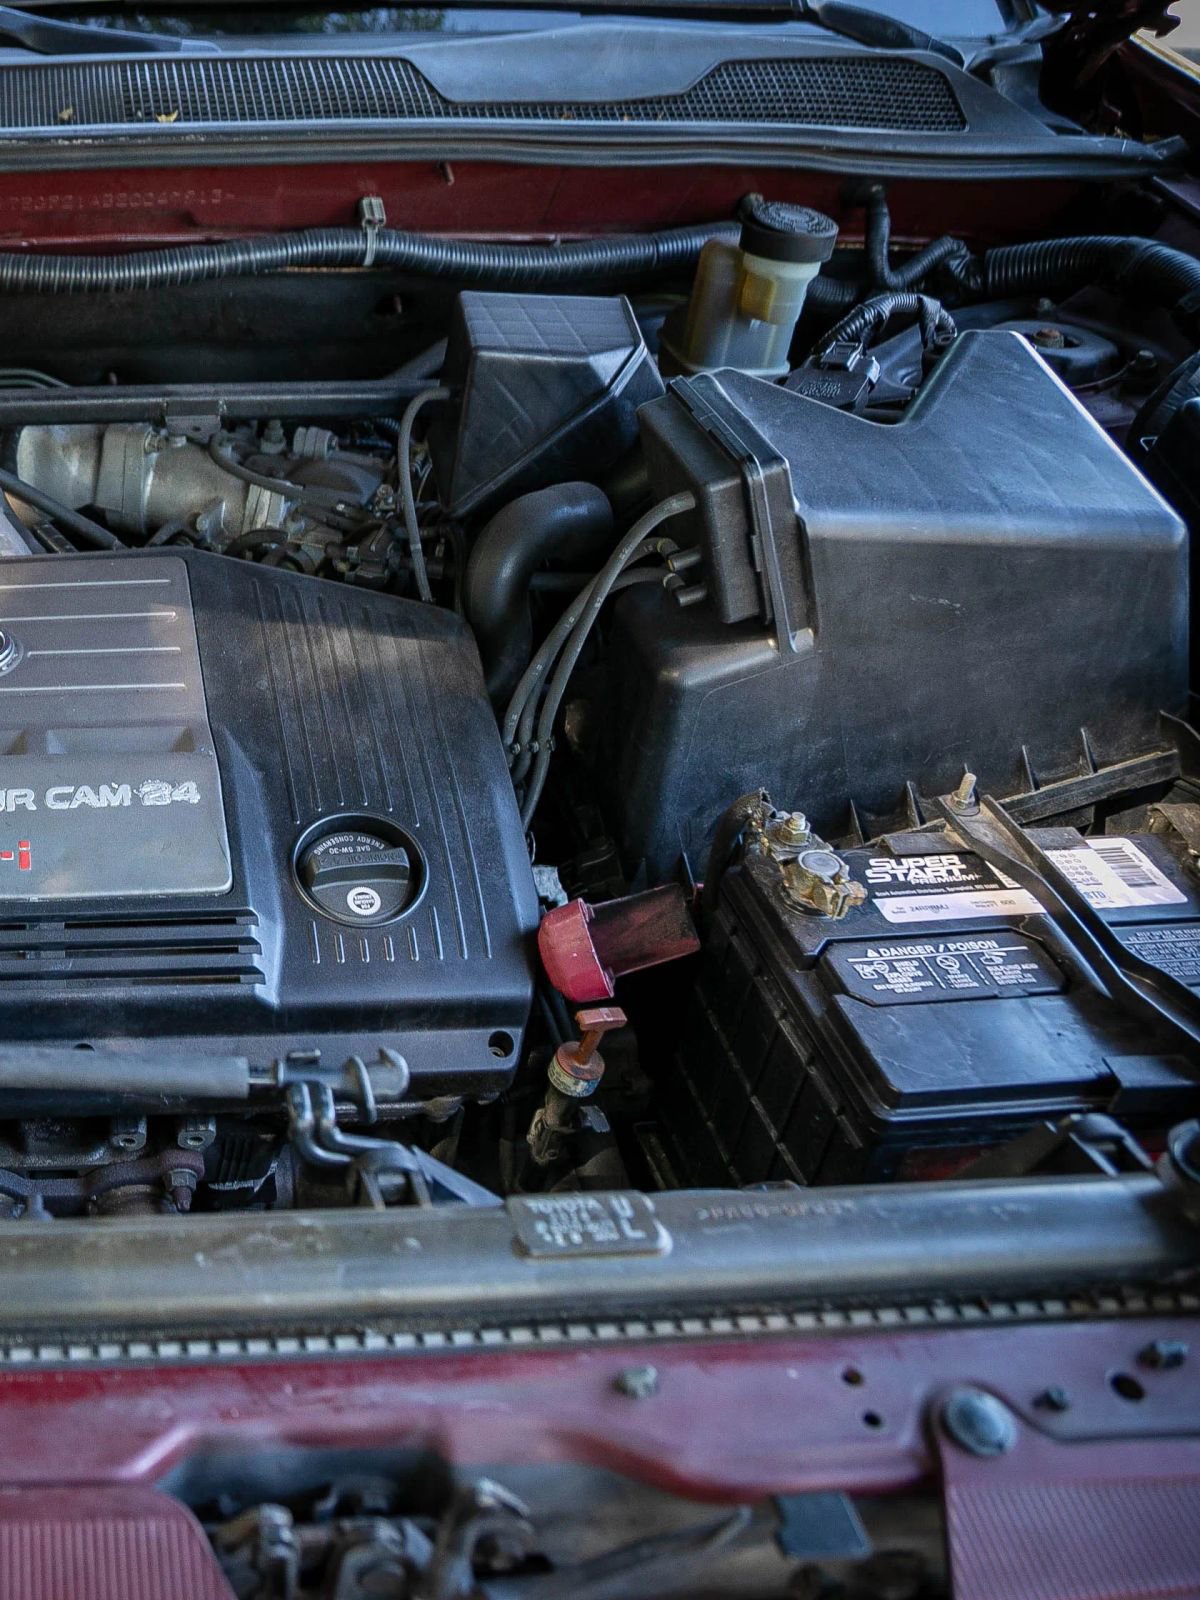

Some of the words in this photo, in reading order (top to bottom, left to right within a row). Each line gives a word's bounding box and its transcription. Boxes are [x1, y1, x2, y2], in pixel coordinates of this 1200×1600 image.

[45, 783, 132, 810] CAM
[313, 835, 354, 856] CONSERVING
[356, 835, 385, 850] ENERGY
[868, 854, 962, 872] SUPER
[865, 864, 967, 884] START
[880, 944, 935, 957] DANGER
[949, 940, 999, 952] POISON
